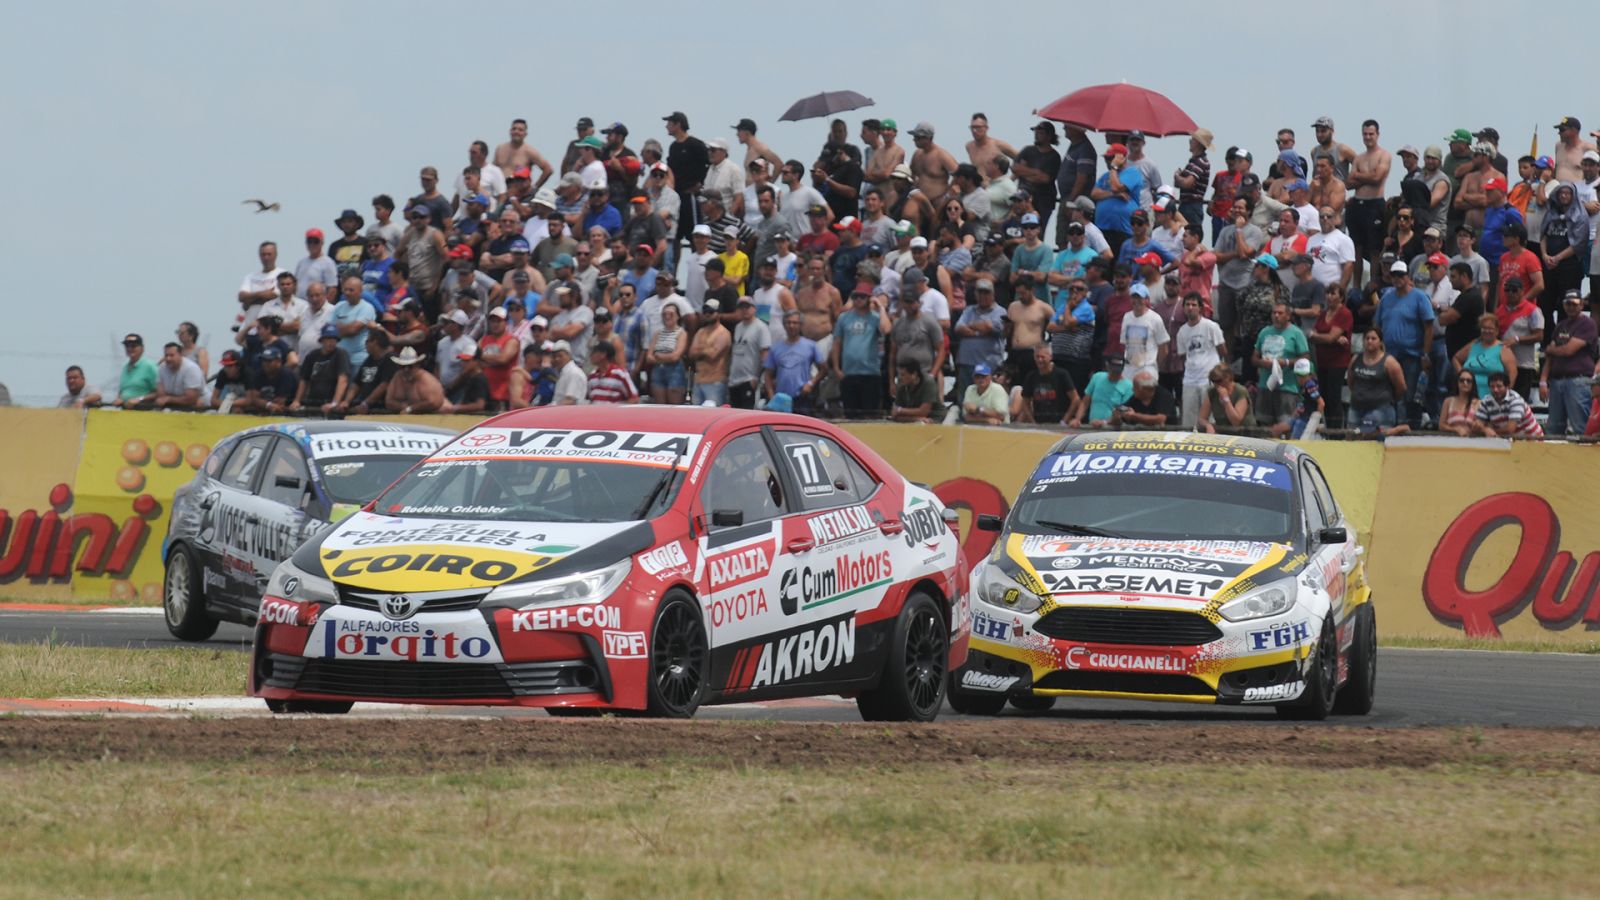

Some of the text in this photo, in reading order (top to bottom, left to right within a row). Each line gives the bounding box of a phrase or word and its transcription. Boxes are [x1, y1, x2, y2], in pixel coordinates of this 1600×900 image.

[237, 446, 263, 483] 2
[445, 448, 563, 457] CONCESIONARIO
[566, 448, 621, 458] OFICIAL
[792, 446, 820, 484] 17
[1233, 448, 1257, 457] SA
[1050, 454, 1276, 480] Montemar
[401, 505, 448, 513] Rodolfo
[339, 528, 547, 542] FONTEZUELA
[807, 505, 876, 546] METALSOL
[352, 534, 518, 546] CEREALES
[711, 547, 769, 587] AXALTA
[1089, 555, 1224, 572] MENDOZA
[802, 550, 892, 603] CumMotors
[1050, 573, 1211, 597] ARSEMET
[512, 605, 621, 632] KEH-COM
[705, 587, 768, 627] TOYOTA
[341, 621, 420, 633] ALFAJORES
[1250, 621, 1311, 650] FGH
[605, 634, 644, 655] YPF
[751, 617, 856, 690] AKRON
[1089, 652, 1187, 671] CRUCIANELLI
